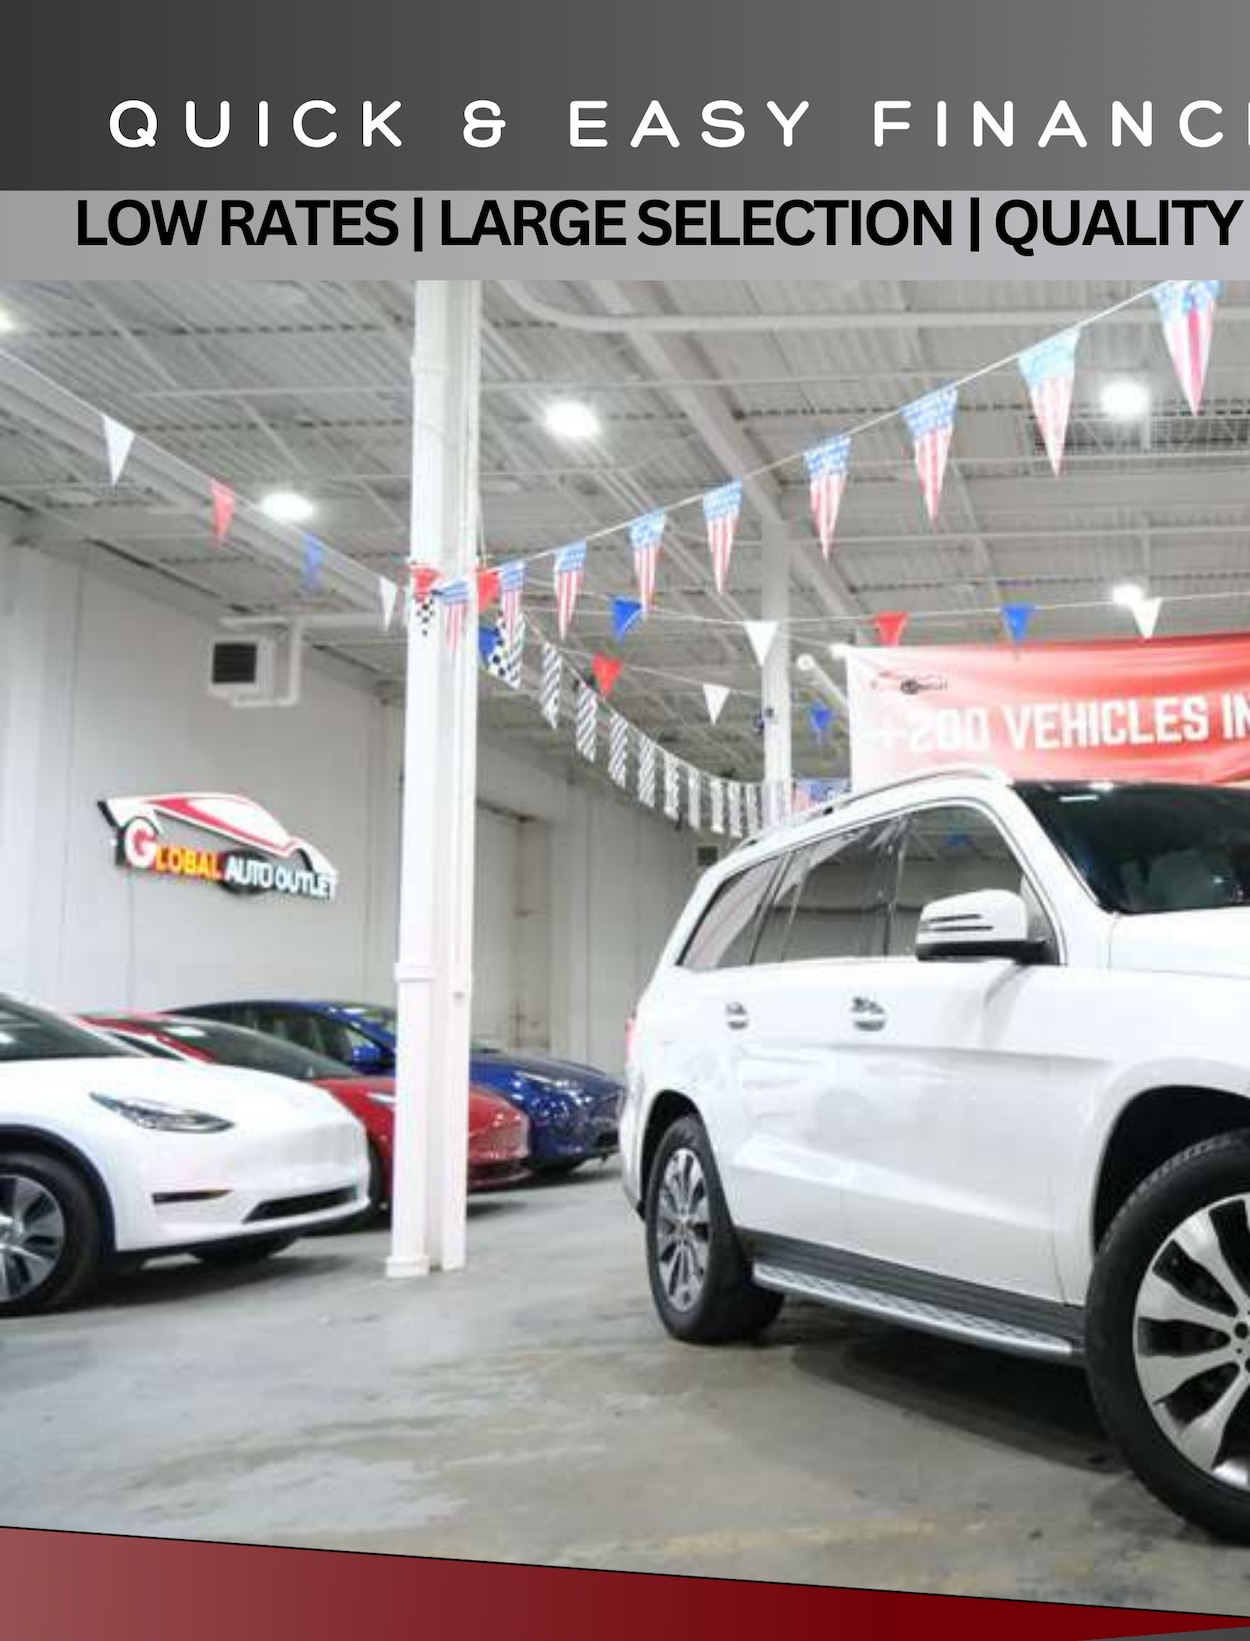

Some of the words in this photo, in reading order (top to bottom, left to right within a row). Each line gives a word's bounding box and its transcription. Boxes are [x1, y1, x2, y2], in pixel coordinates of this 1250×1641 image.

[1002, 695, 1211, 750] VEHICLES
[124, 818, 223, 882] GLOBAL
[224, 856, 272, 889] AUTO
[275, 864, 336, 900] OUTLET
